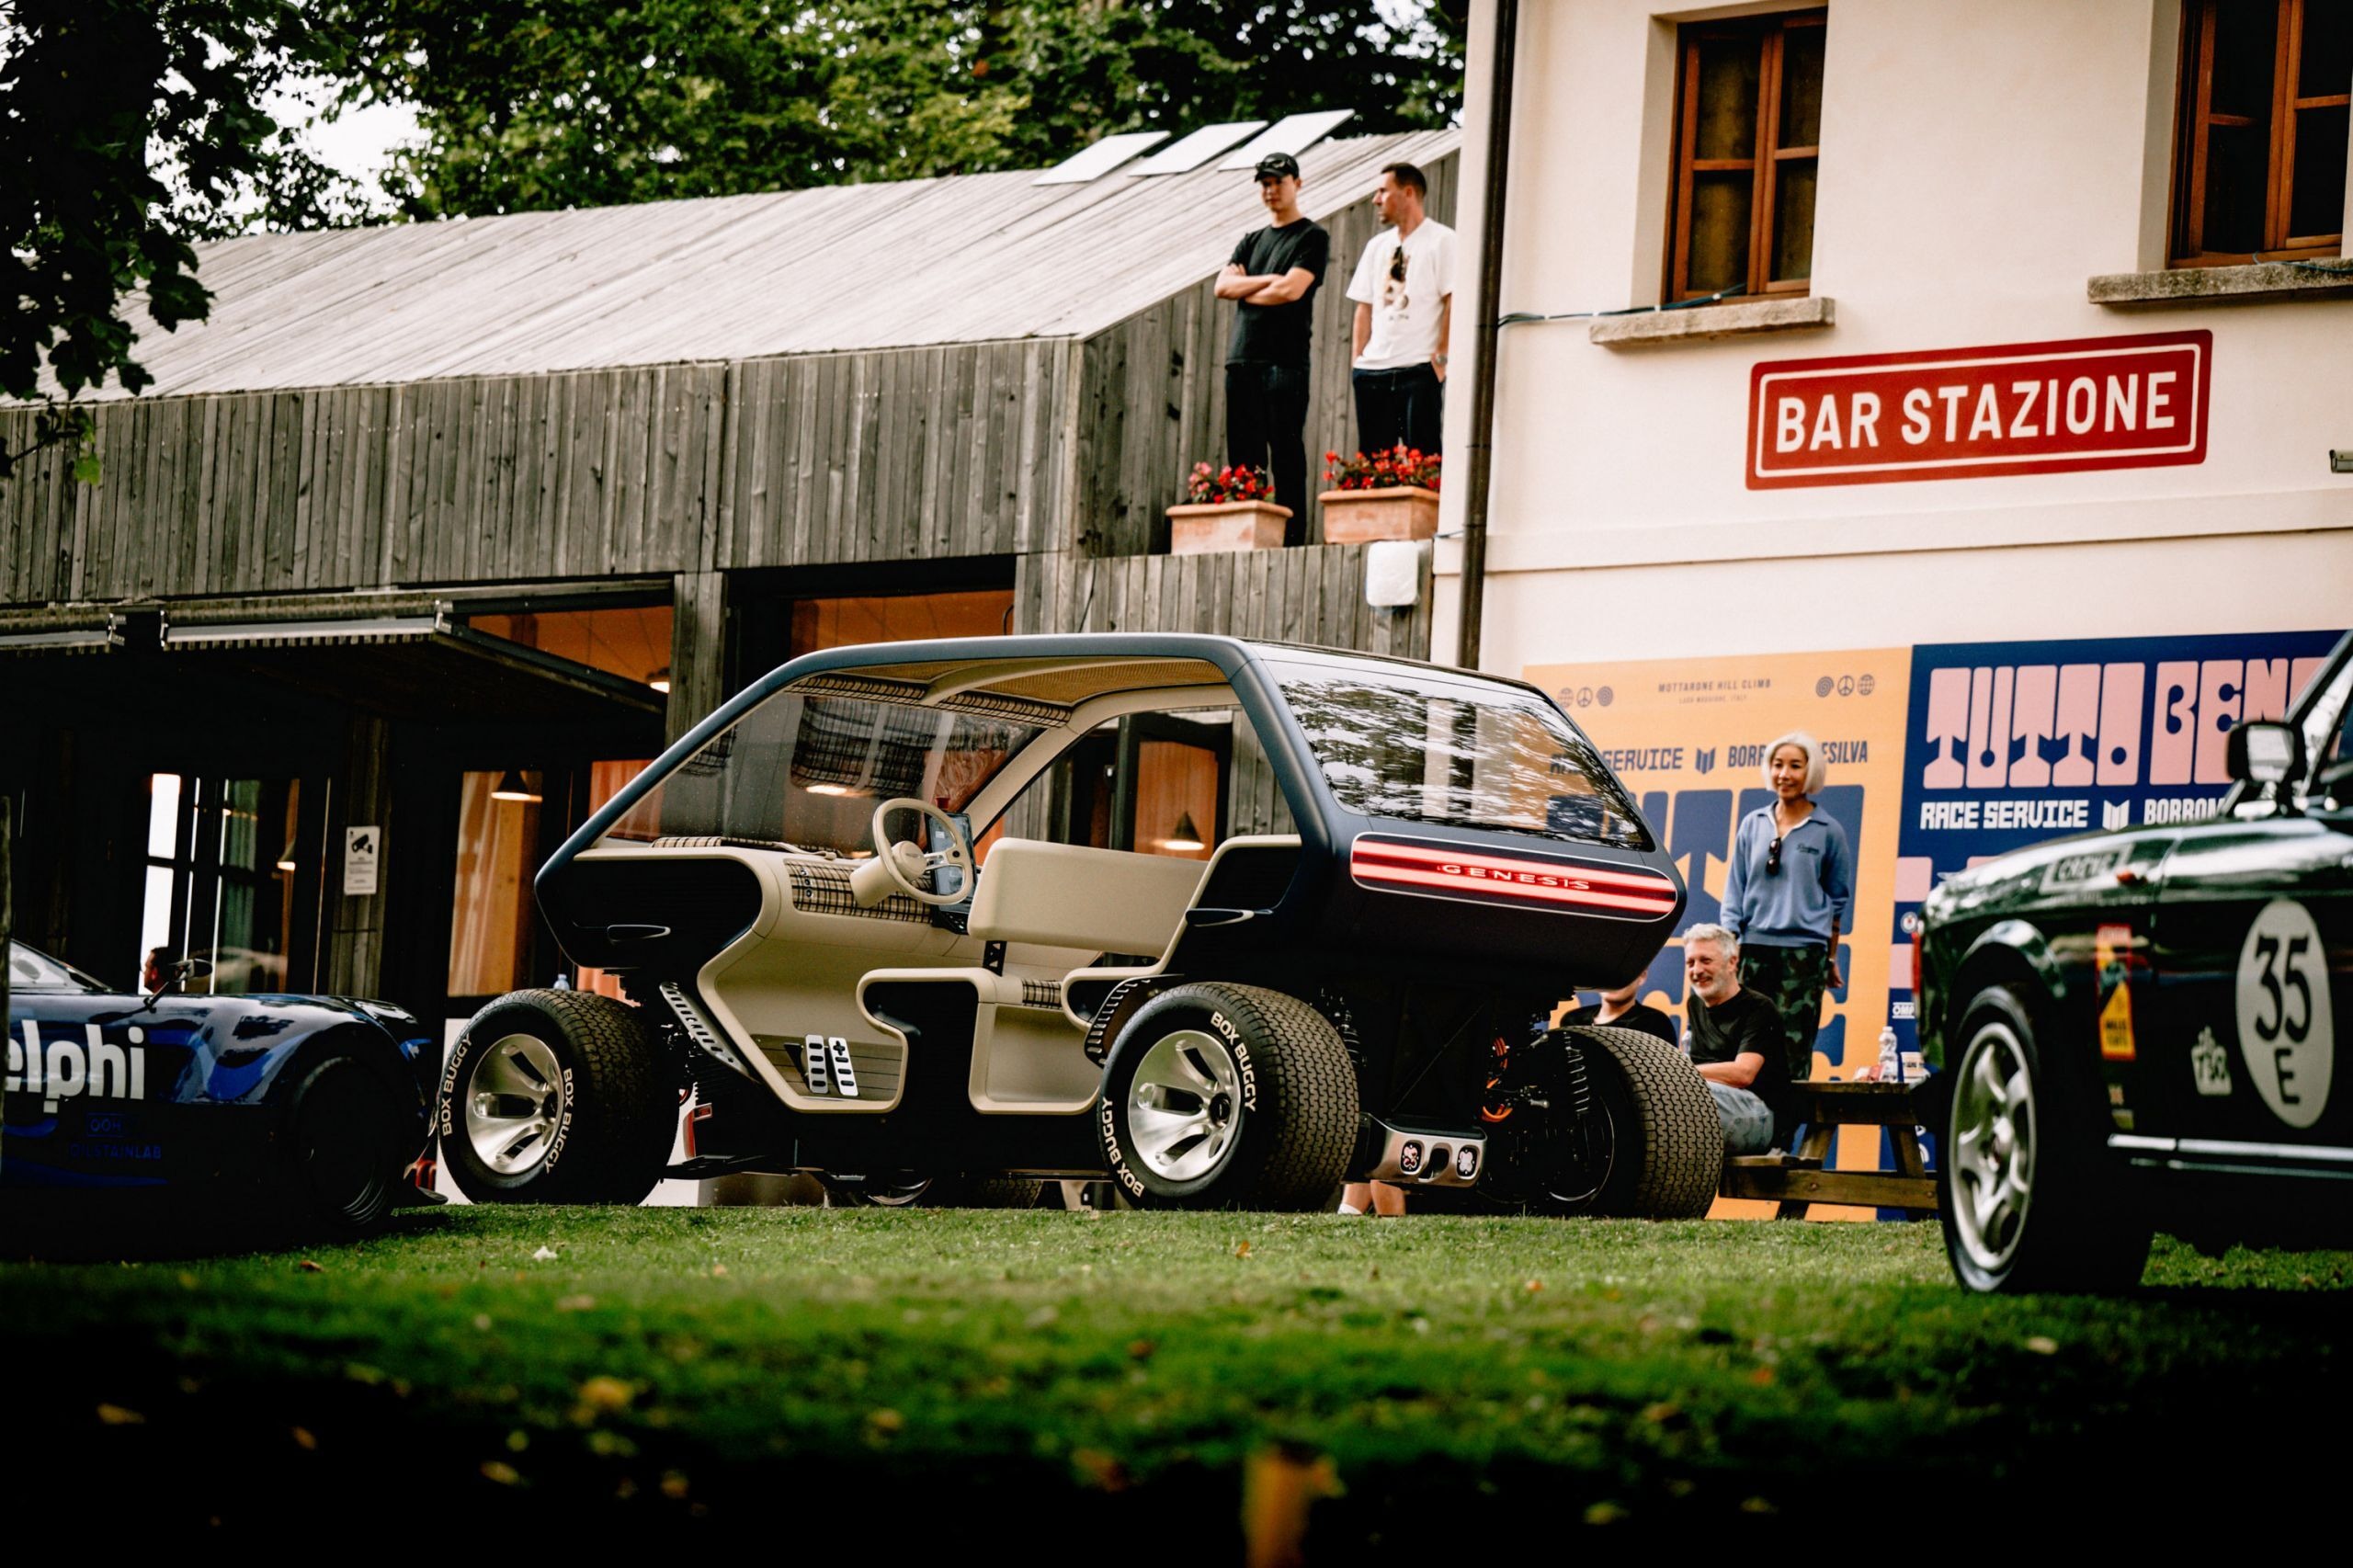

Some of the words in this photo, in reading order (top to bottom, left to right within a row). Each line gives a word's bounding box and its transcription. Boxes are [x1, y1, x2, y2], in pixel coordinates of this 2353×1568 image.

[1775, 392, 1881, 454] BAR
[1901, 370, 2177, 446] STAZIONE
[1658, 681, 1714, 693] MOTTARONE
[1717, 680, 1737, 690] HILL
[1741, 678, 1771, 689] CLIMB
[1923, 662, 2145, 790] TUTTO
[2149, 656, 2340, 785] BEN
[1602, 747, 1683, 771] SERVICE
[1920, 801, 1980, 830] RACE
[1983, 800, 2089, 829] SERVICE
[1442, 864, 1590, 890] GENESIS
[2255, 931, 2313, 1043] 35
[443, 1033, 473, 1093] BUGGY
[563, 1068, 574, 1107] BOX
[1210, 1011, 1240, 1045] BOX
[1234, 1043, 1256, 1112] BUGGY
[2275, 1048, 2301, 1105] E
[441, 1096, 453, 1136] BOX
[545, 1113, 572, 1174] BUGGY
[1102, 1097, 1122, 1165] BUGGY
[1117, 1164, 1145, 1198] BOX
